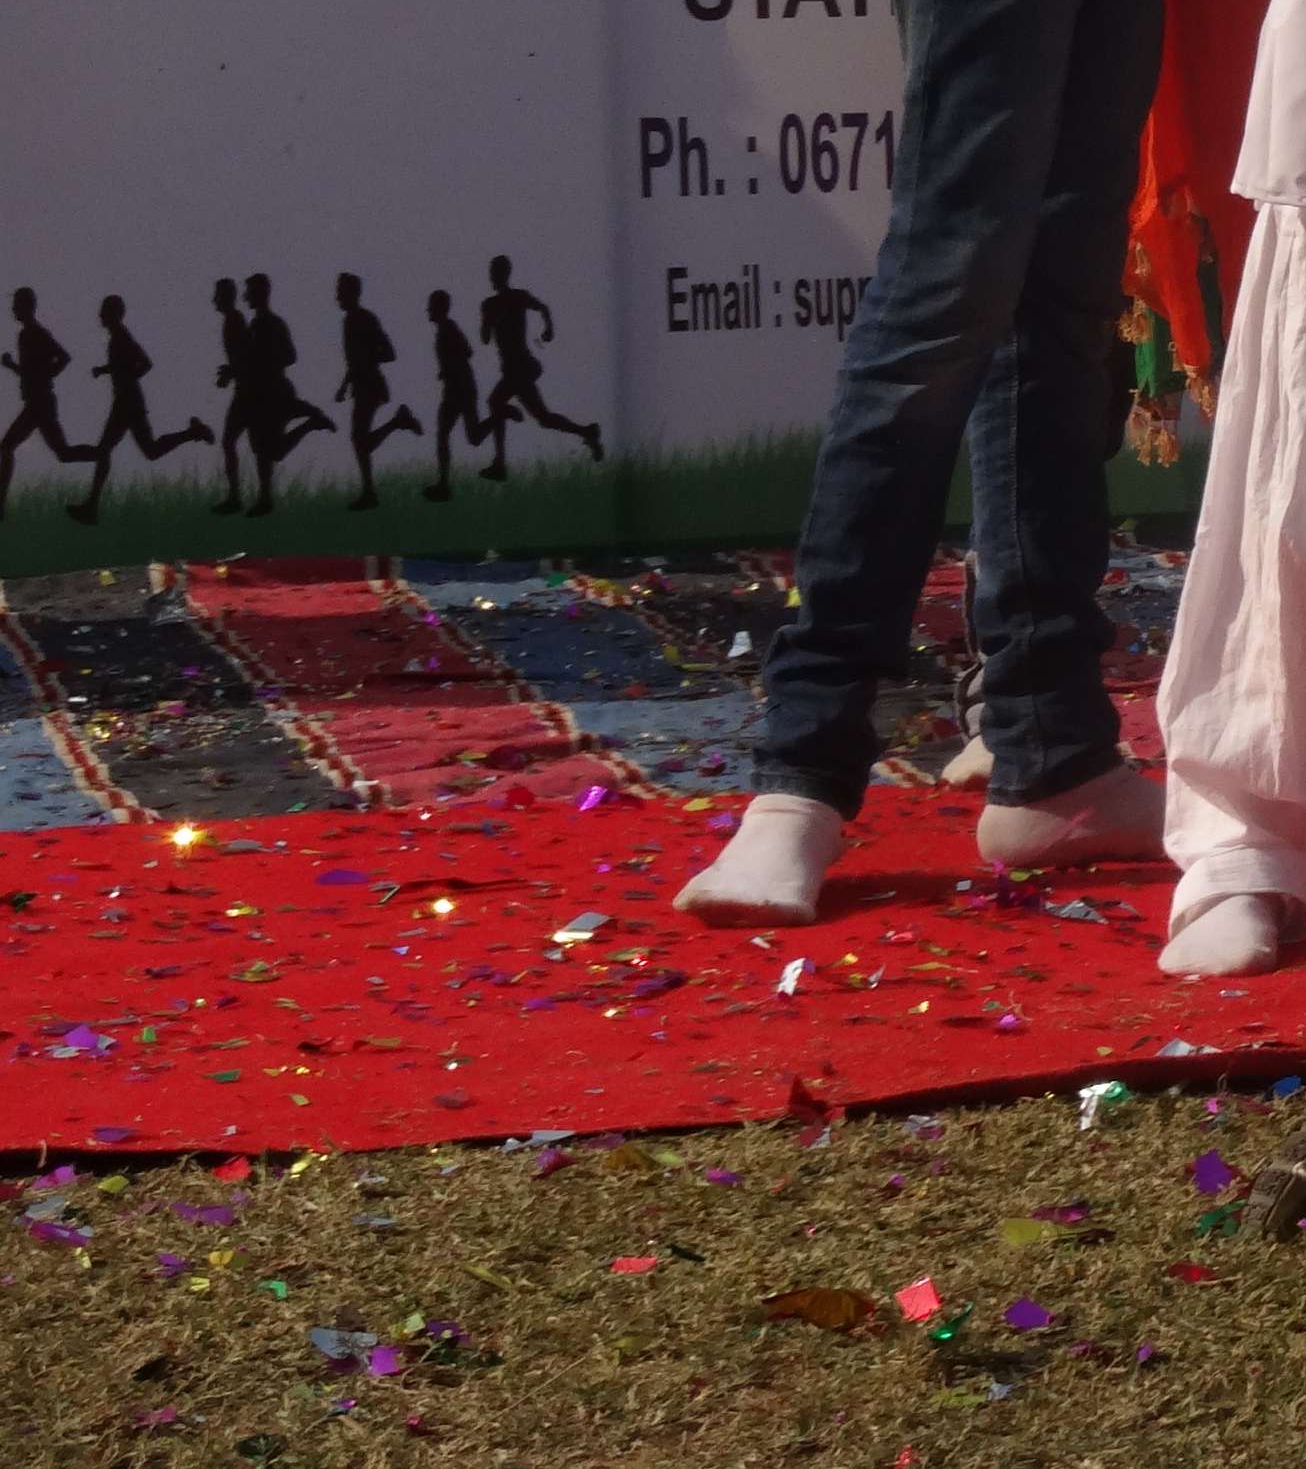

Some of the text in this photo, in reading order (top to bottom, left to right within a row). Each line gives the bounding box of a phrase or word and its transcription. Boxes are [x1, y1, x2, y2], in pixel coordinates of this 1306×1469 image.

[639, 115, 726, 199] Ph.
[666, 263, 761, 333] Email
[793, 276, 873, 343] sup
